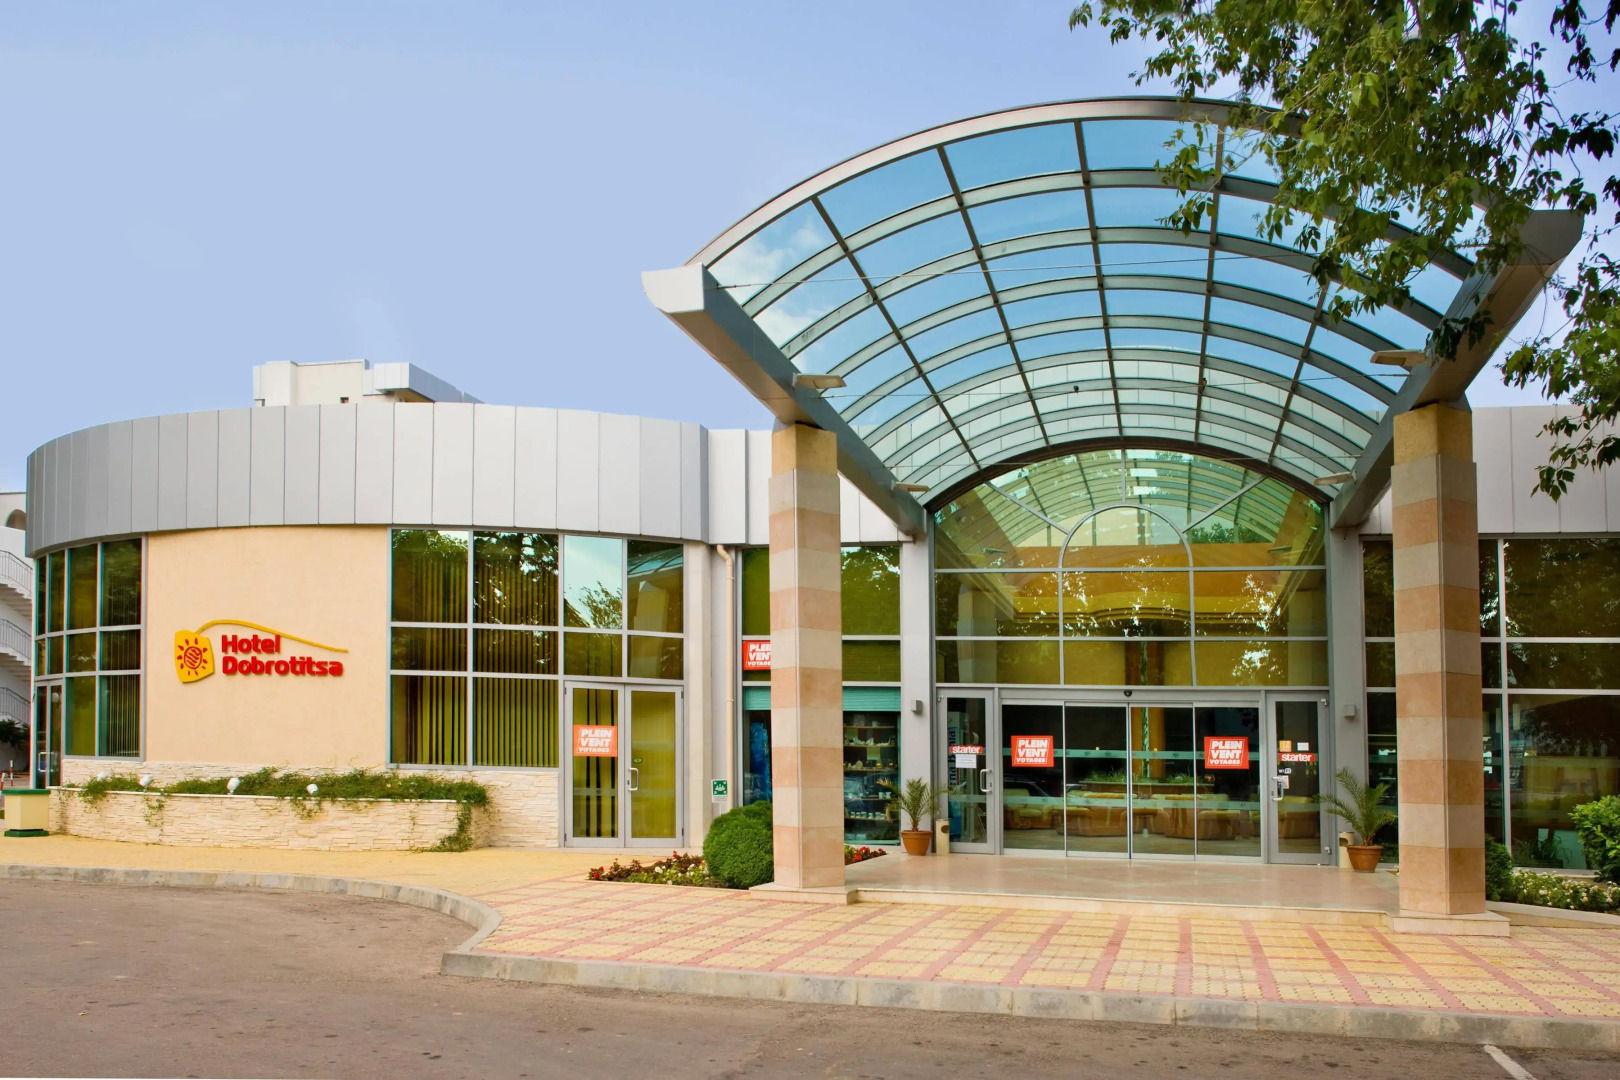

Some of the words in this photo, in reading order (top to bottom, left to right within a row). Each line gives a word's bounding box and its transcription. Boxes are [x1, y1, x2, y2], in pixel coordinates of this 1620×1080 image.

[221, 634, 281, 653] Hotel
[749, 643, 771, 652] PLEI
[222, 656, 344, 676] Dobrotitsa
[581, 729, 613, 738] PLEIN
[580, 738, 612, 747] VENT
[1018, 739, 1048, 748] PLEIN
[1211, 740, 1244, 750] PLEIN
[952, 745, 981, 754] starter
[1017, 748, 1048, 758] VENT
[1210, 750, 1242, 759] VENT
[1281, 753, 1313, 762] starter
